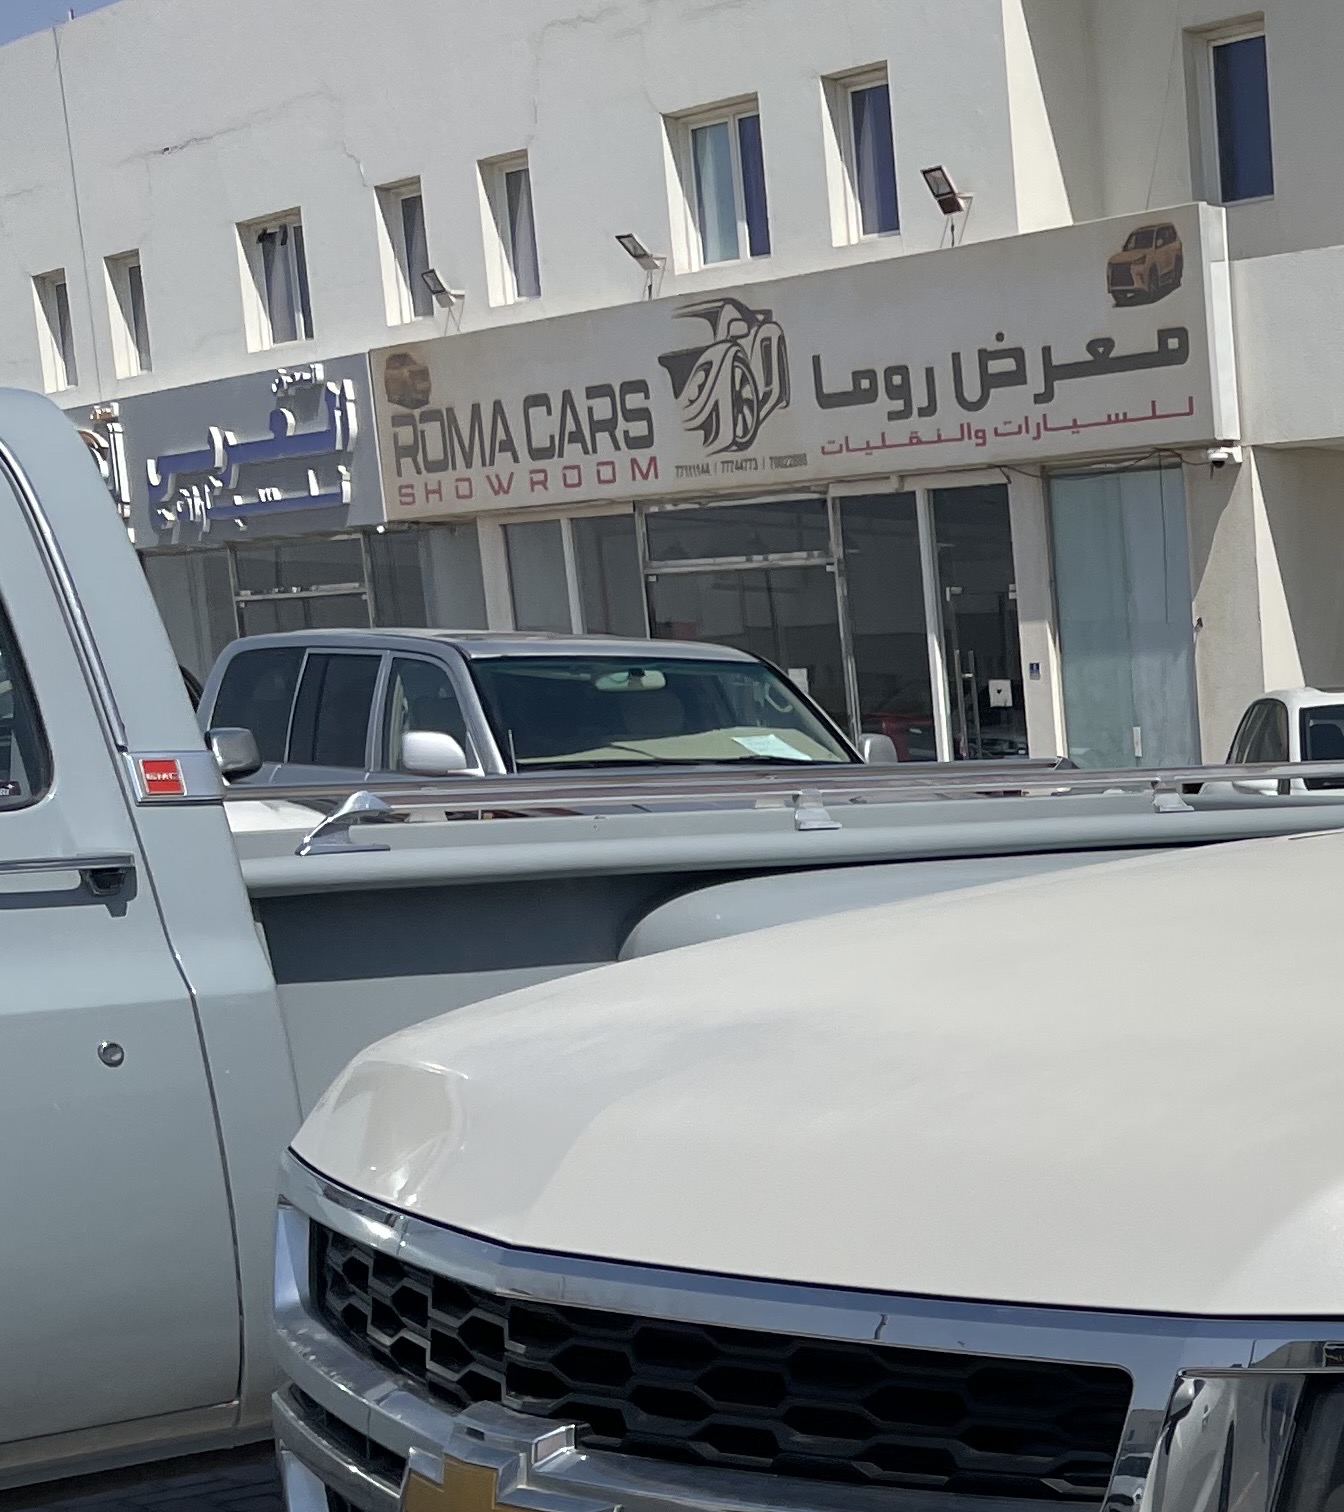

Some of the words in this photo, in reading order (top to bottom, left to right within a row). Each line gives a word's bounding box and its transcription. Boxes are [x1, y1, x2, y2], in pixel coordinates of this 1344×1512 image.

[811, 351, 937, 422] روما
[953, 325, 1190, 412] معرض
[391, 399, 520, 478] ROMA
[522, 378, 655, 462] CARS
[820, 422, 988, 457] والنقليات
[993, 395, 1195, 441] للسيارات
[398, 455, 660, 507] SHOWROOM
